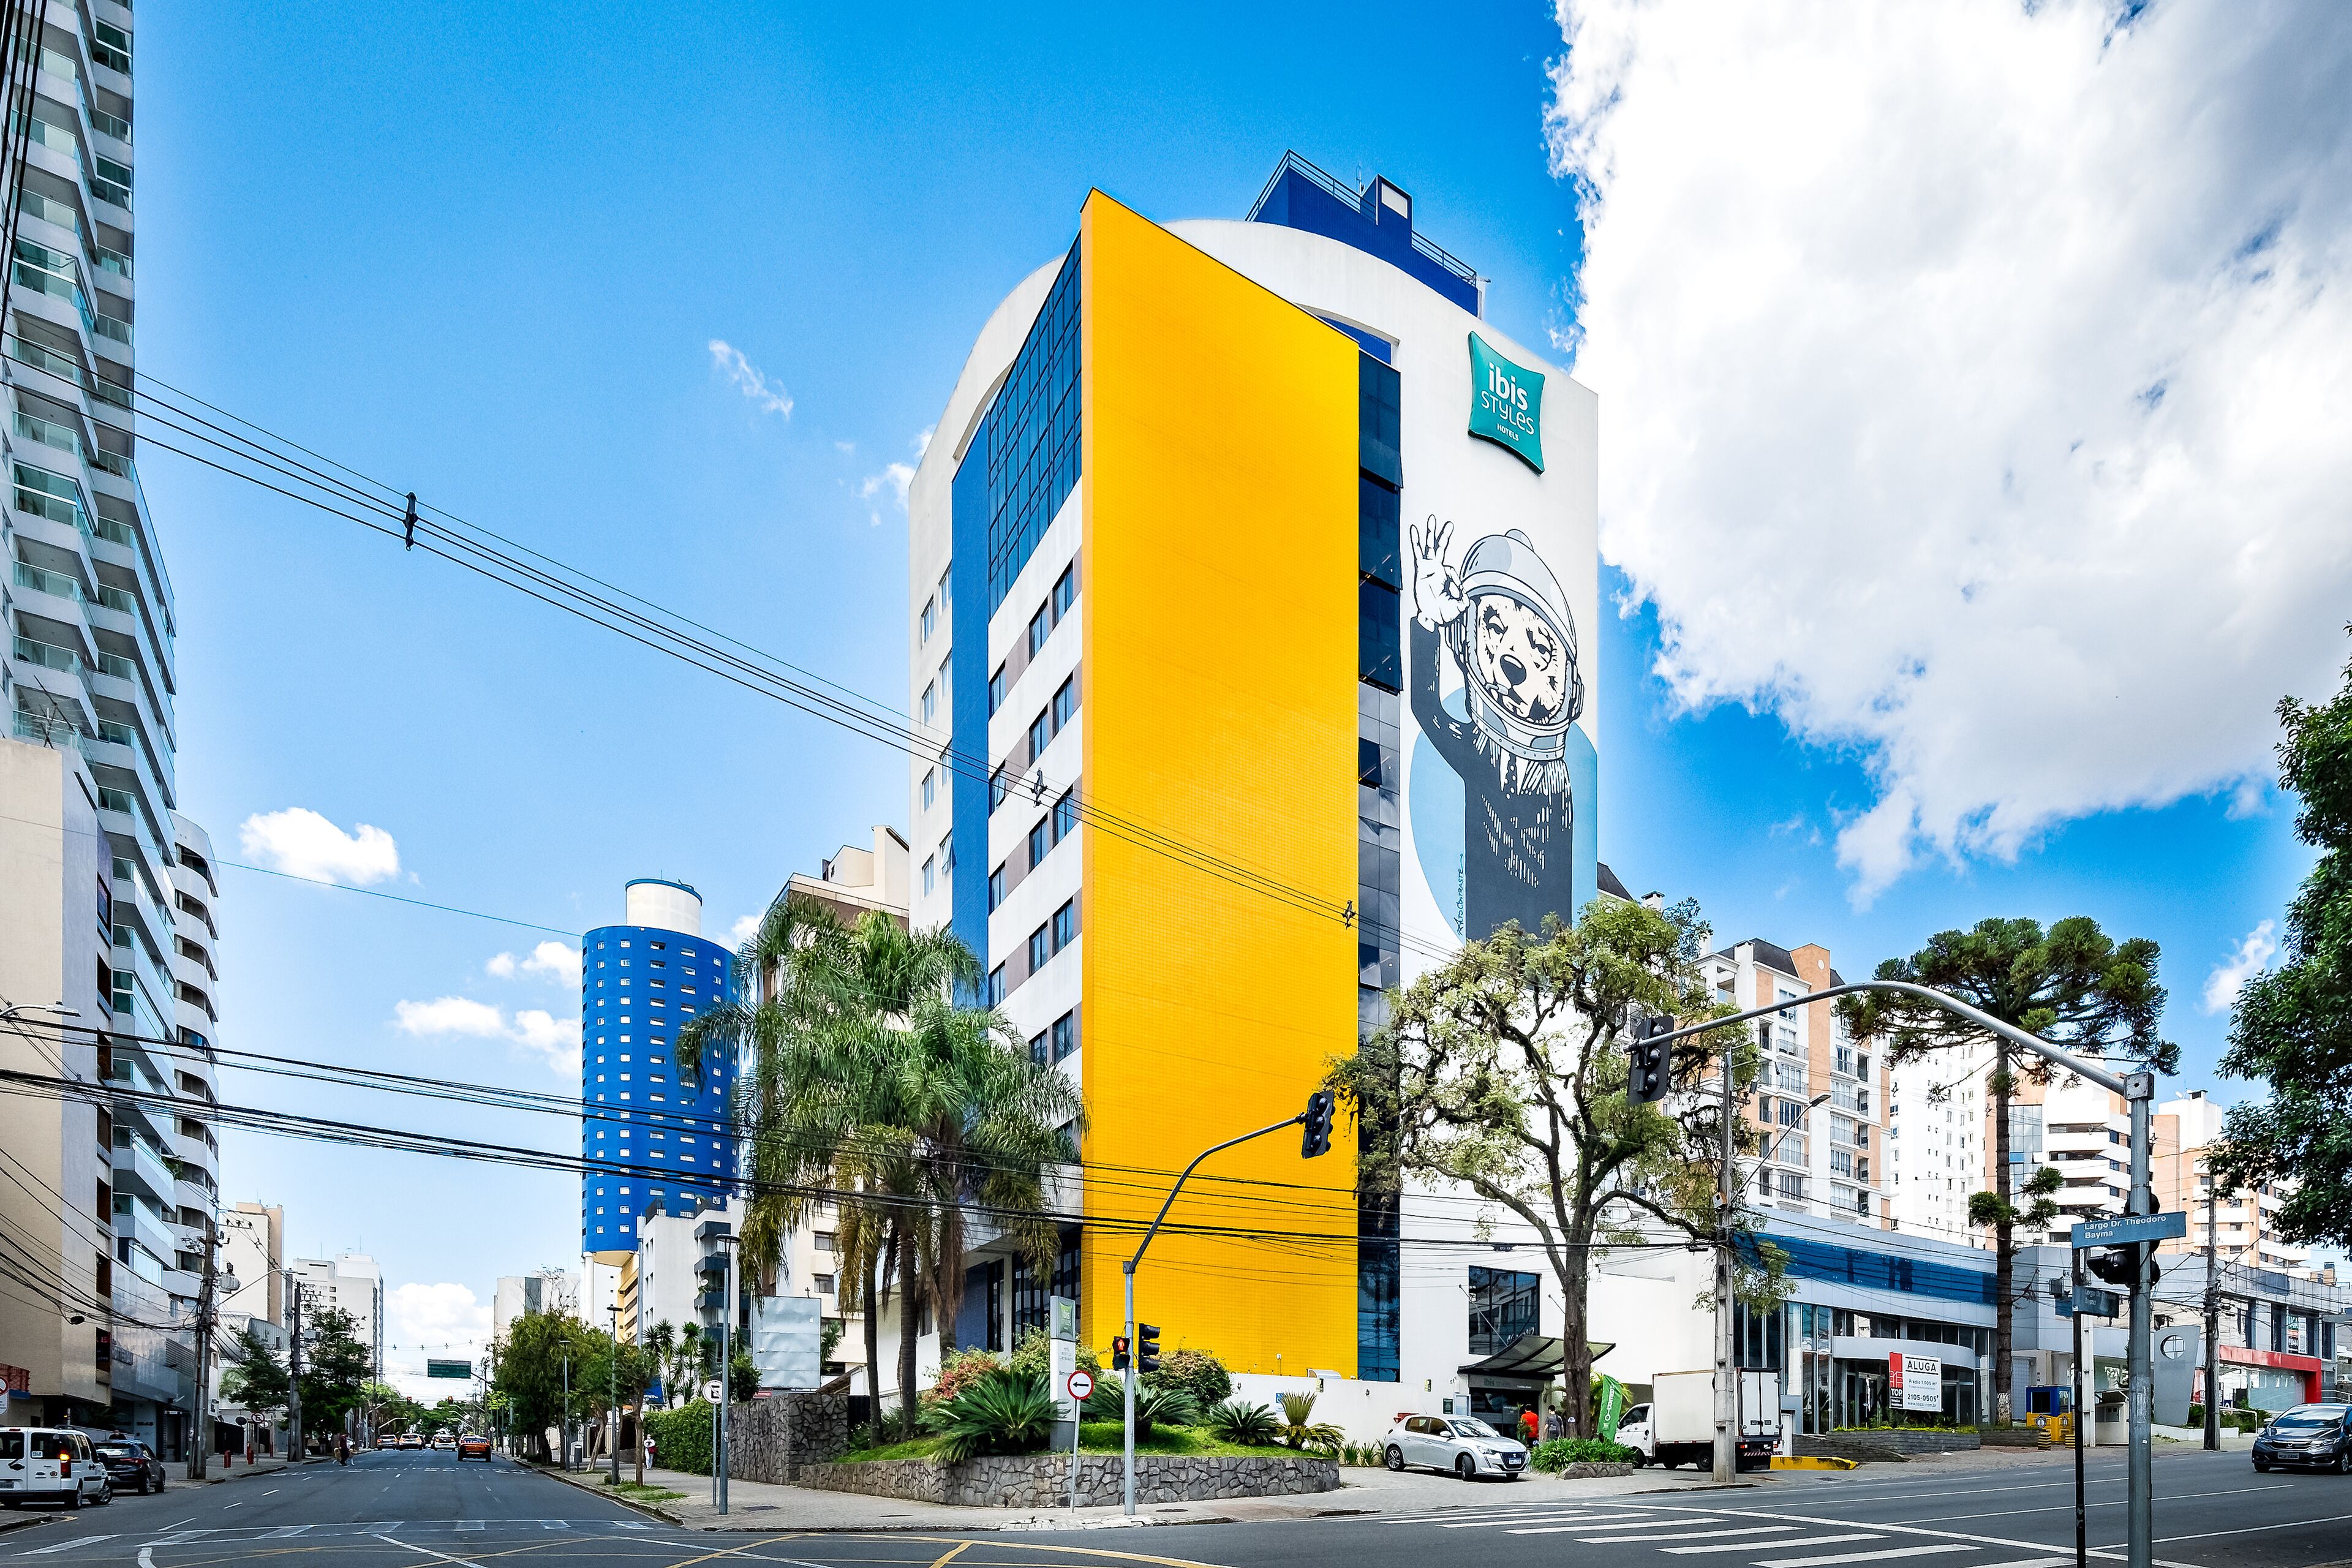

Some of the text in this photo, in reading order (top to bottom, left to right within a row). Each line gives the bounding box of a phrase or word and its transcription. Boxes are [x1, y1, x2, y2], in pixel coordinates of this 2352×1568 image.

[1488, 361, 1528, 411] ibis
[1497, 423, 1520, 442] HOTELS
[2084, 1222, 2108, 1231] Largo
[2125, 1216, 2166, 1226] Theodoro
[2084, 1231, 2113, 1240] Bayma
[1907, 1360, 1936, 1372] ALUGA
[1891, 1388, 1902, 1396] TOP
[1605, 1384, 1615, 1421] ABERTO
